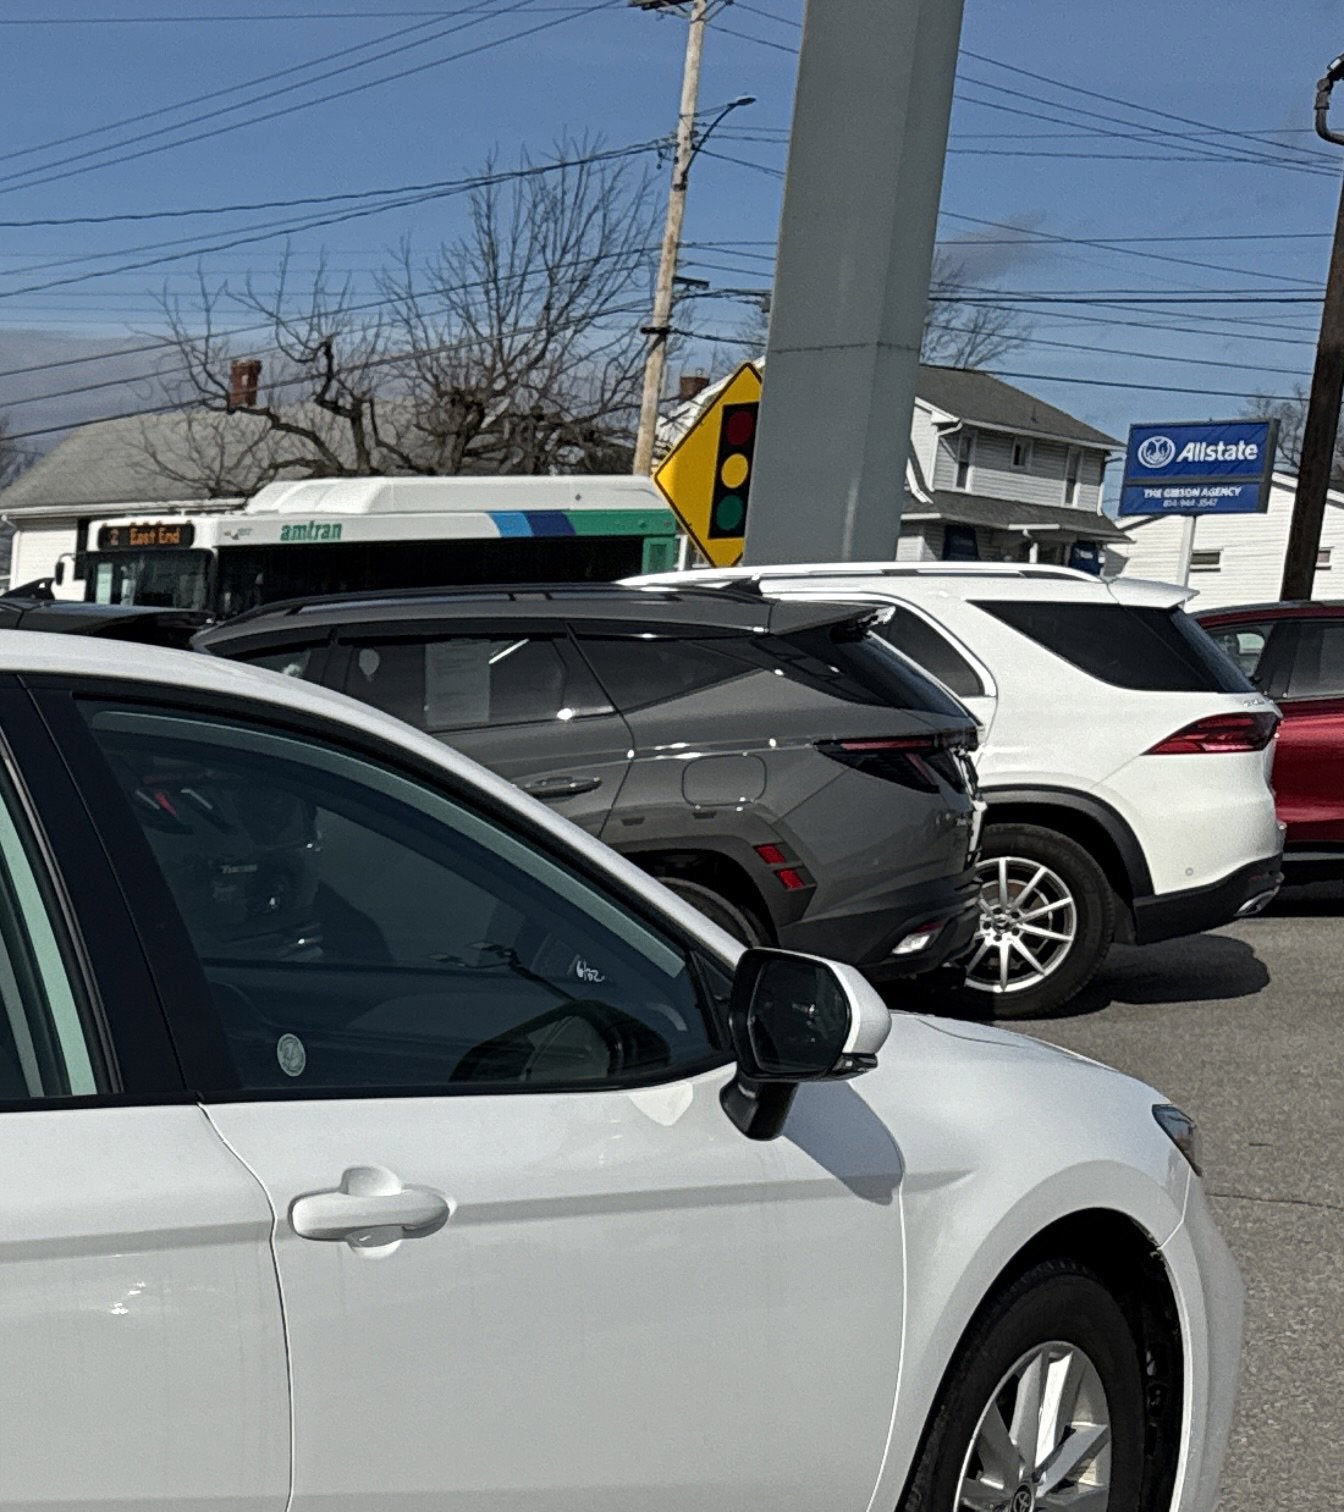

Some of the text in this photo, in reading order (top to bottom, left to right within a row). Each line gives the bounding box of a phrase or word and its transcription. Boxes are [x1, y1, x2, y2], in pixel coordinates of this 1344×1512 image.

[1176, 440, 1258, 462] Allstate
[1144, 488, 1162, 498] THE
[1201, 486, 1242, 497] AGENCY
[130, 528, 155, 545] East
[159, 527, 181, 544] End
[280, 520, 342, 541] amtran
